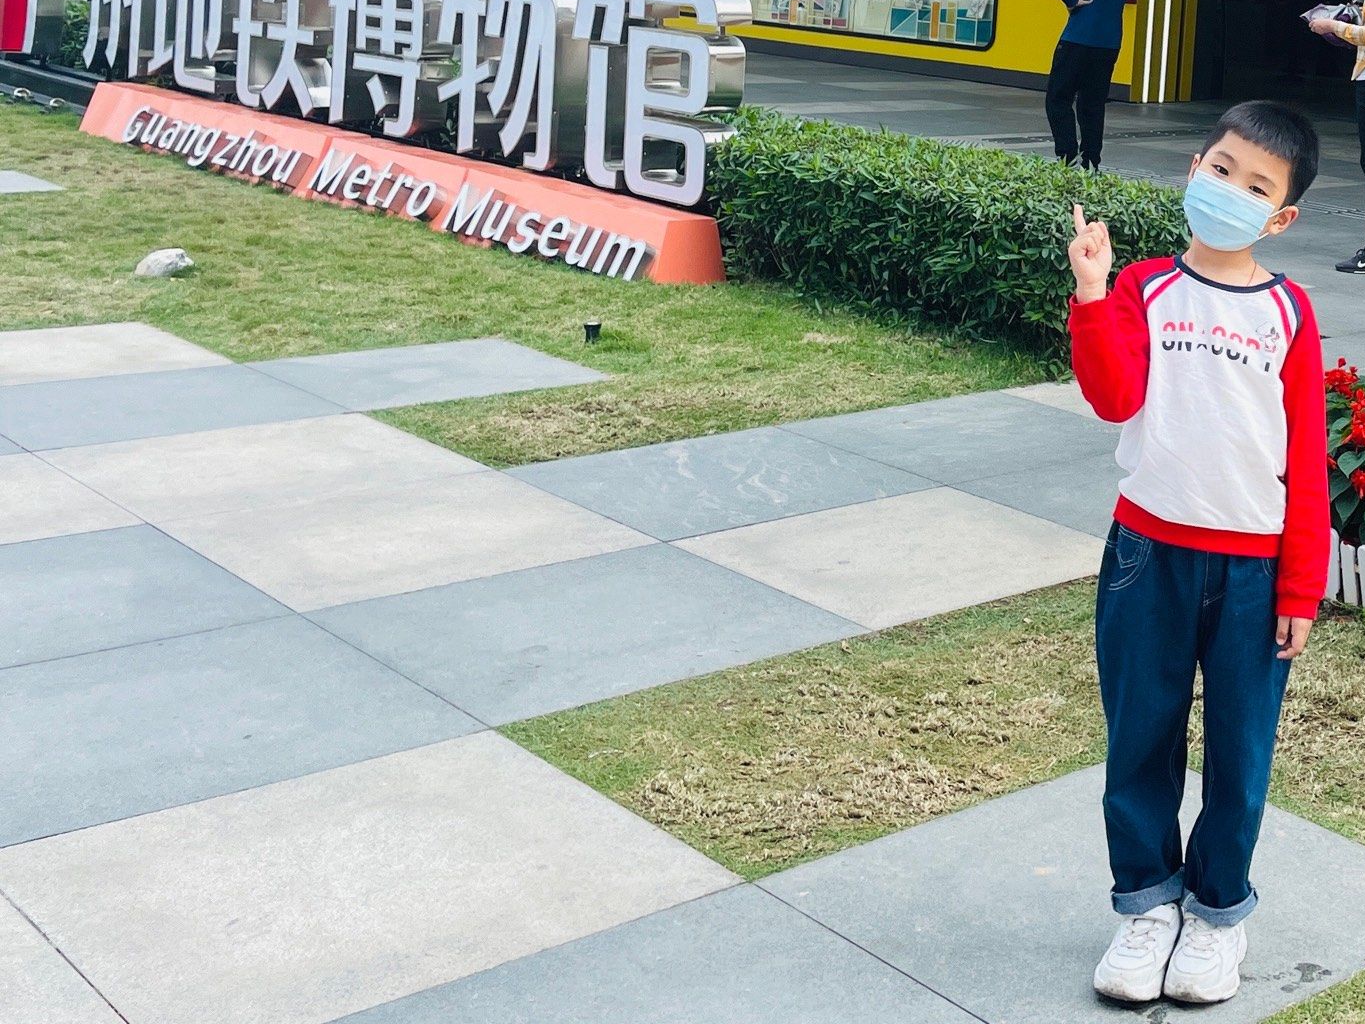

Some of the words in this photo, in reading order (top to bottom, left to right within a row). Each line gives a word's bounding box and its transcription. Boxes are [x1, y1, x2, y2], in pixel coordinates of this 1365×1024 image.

[122, 104, 301, 184] Guangzhou
[307, 148, 437, 219] Metro
[443, 182, 647, 281] Museum
